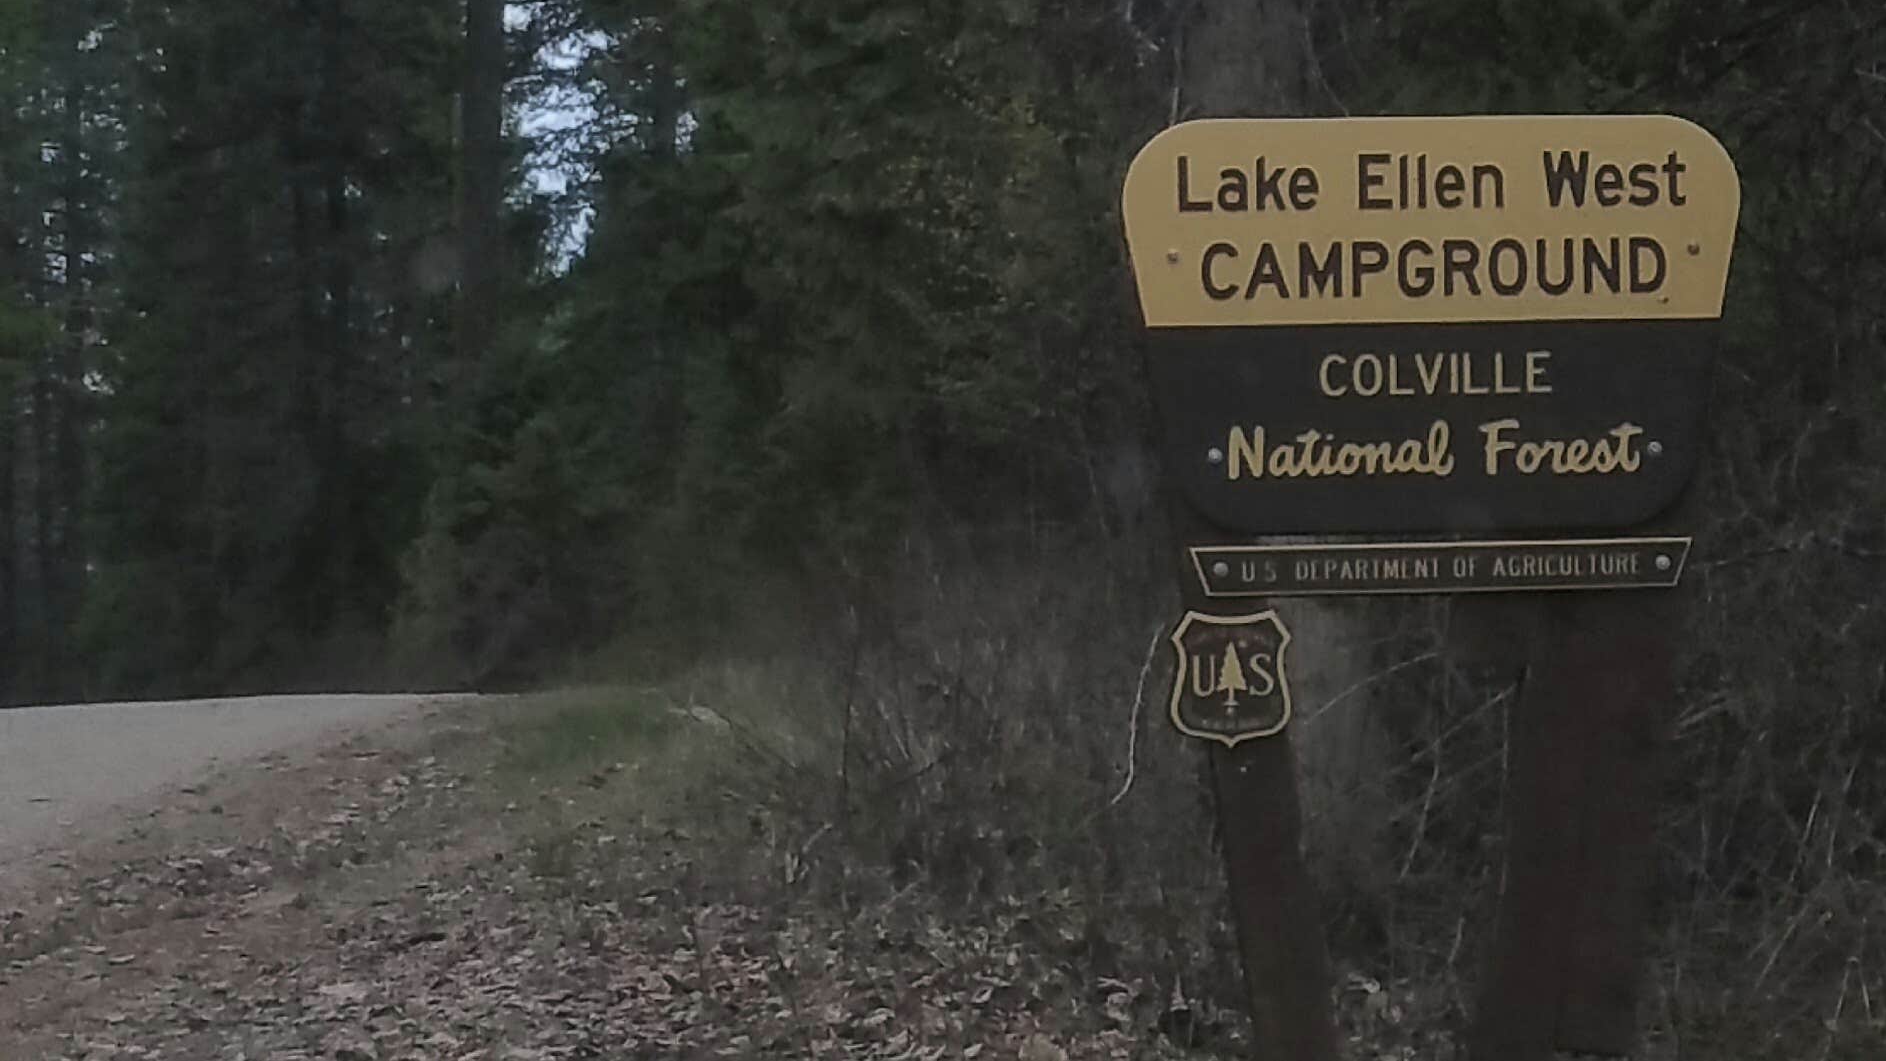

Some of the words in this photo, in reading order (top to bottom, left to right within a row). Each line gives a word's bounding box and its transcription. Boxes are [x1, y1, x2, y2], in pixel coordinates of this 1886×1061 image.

[1176, 154, 1321, 213] Lake
[1357, 152, 1505, 211] Ellen
[1544, 150, 1688, 208] West
[1200, 237, 1668, 300] CAMPGROUND
[1319, 351, 1554, 396] COLVILLE
[1227, 420, 1455, 480] National
[1479, 419, 1644, 476] Forest
[1295, 556, 1440, 581] DEPARTMENT
[1453, 557, 1478, 577] OF
[1492, 552, 1640, 577] AGRICULTURE
